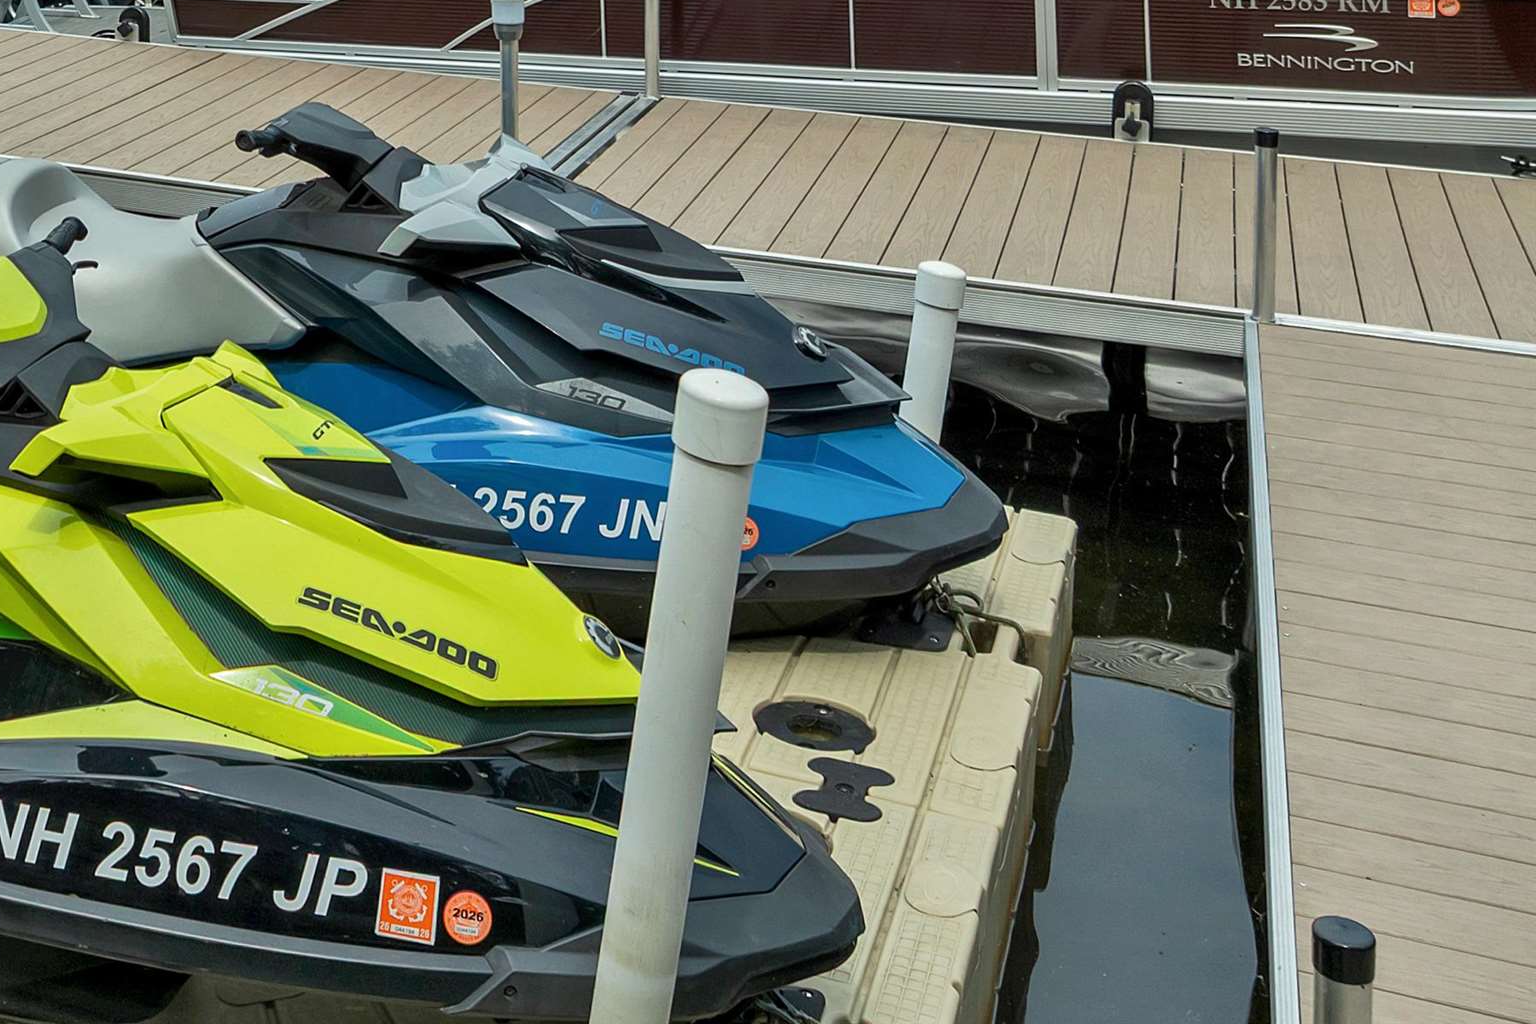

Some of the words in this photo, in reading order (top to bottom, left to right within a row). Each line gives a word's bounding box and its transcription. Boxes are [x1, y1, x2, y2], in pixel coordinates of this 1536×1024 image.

[1237, 52, 1415, 74] BENNINGTON
[568, 385, 626, 410] 130
[473, 487, 586, 535] 2567
[598, 498, 667, 541] JN
[255, 678, 334, 717] 130
[94, 821, 259, 901] 2567
[272, 852, 369, 917] JP
[452, 907, 484, 922] 2026
